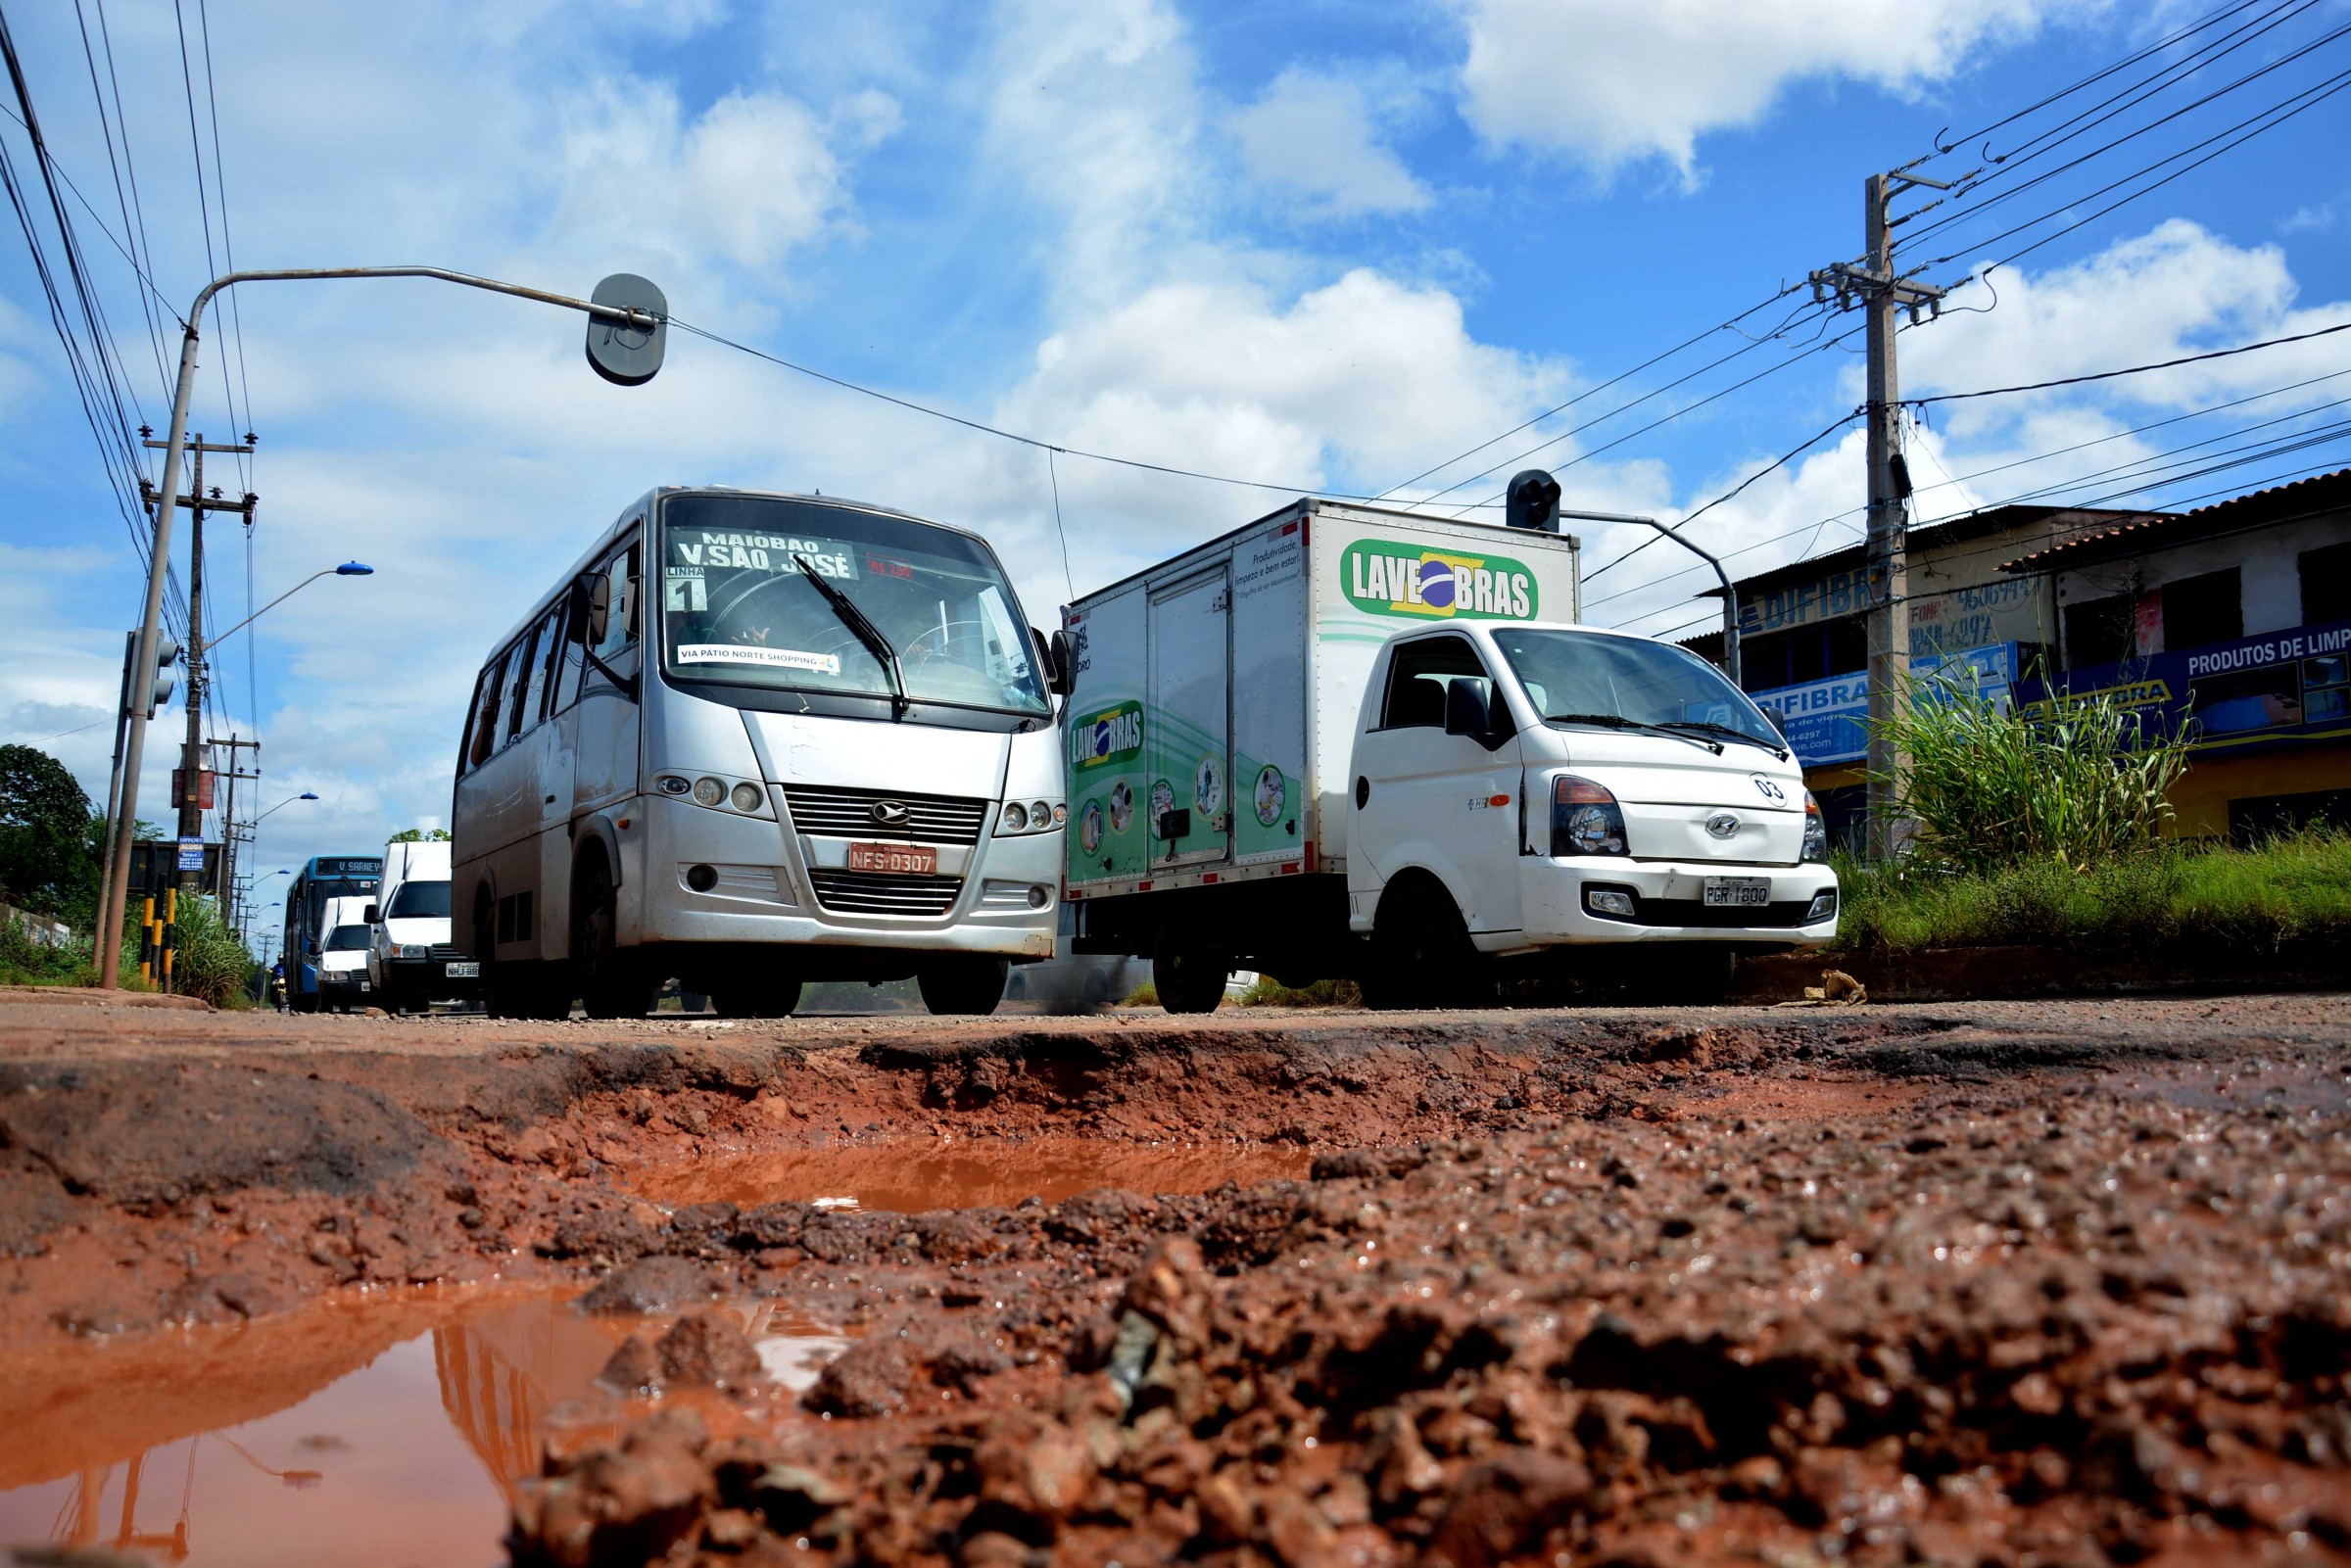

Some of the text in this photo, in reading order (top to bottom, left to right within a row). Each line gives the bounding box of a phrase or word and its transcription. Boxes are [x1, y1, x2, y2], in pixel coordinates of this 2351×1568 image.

[667, 567, 704, 577] LINHA
[781, 551, 851, 579] JOSÉ
[1265, 563, 1280, 575] bem
[675, 581, 693, 611] 1
[700, 648, 730, 657] PÁTIO
[732, 651, 765, 660] NORTE
[767, 653, 817, 666] SHOPPING
[2188, 628, 2351, 675] PRODUTOS DE LIMP
[1799, 718, 1813, 727] de
[1754, 778, 1785, 800] 03
